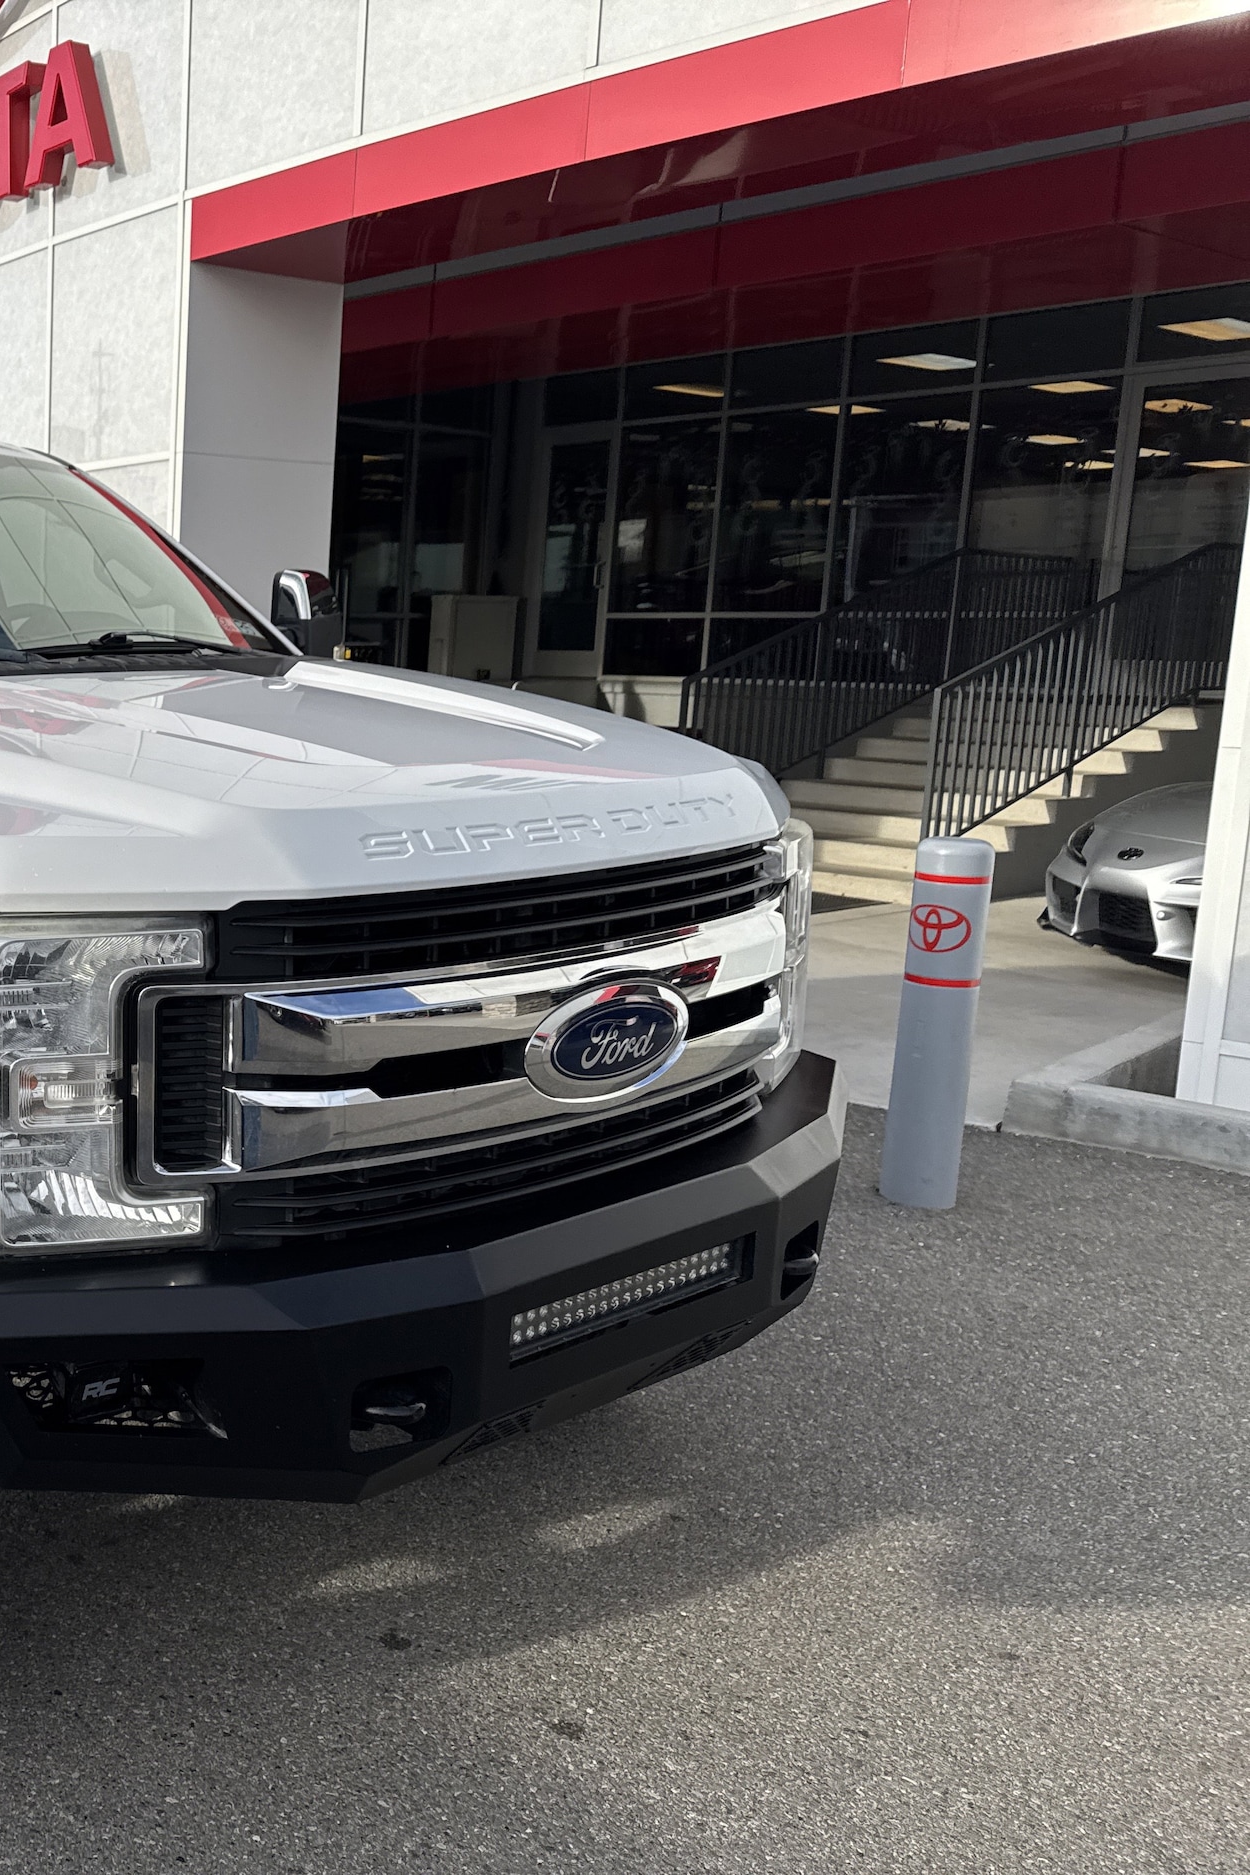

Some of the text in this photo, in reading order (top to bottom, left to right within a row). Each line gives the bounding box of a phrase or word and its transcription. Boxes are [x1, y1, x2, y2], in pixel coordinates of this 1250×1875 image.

[358, 793, 738, 861] SUPER DUTY
[580, 1015, 658, 1070] Ford
[82, 1377, 120, 1401] RC
